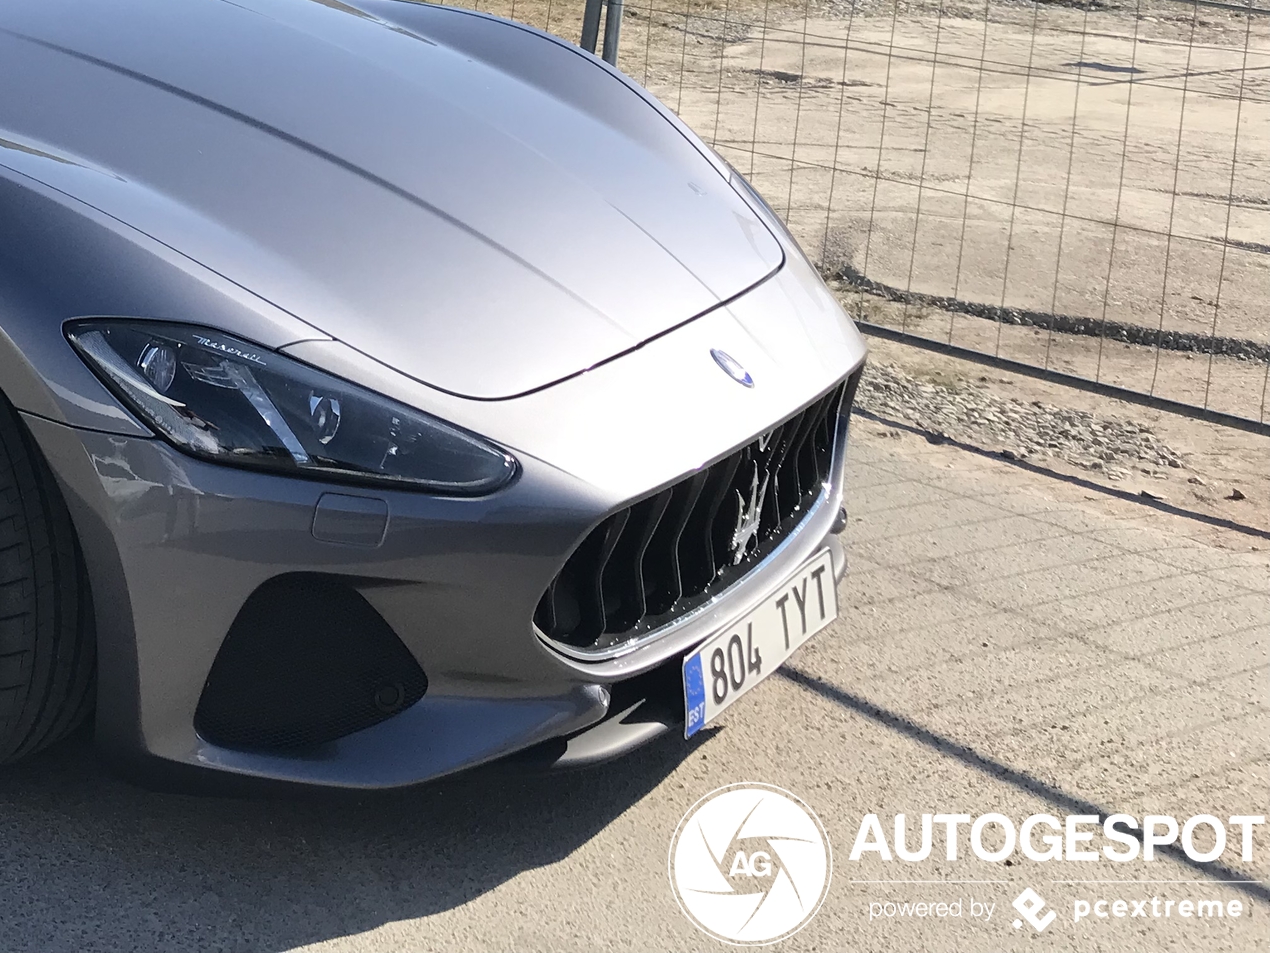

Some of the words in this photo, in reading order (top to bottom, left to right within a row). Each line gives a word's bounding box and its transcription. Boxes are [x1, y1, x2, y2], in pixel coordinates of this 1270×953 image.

[710, 621, 763, 706] 804
[775, 564, 826, 651] TYT
[688, 702, 705, 727] EST
